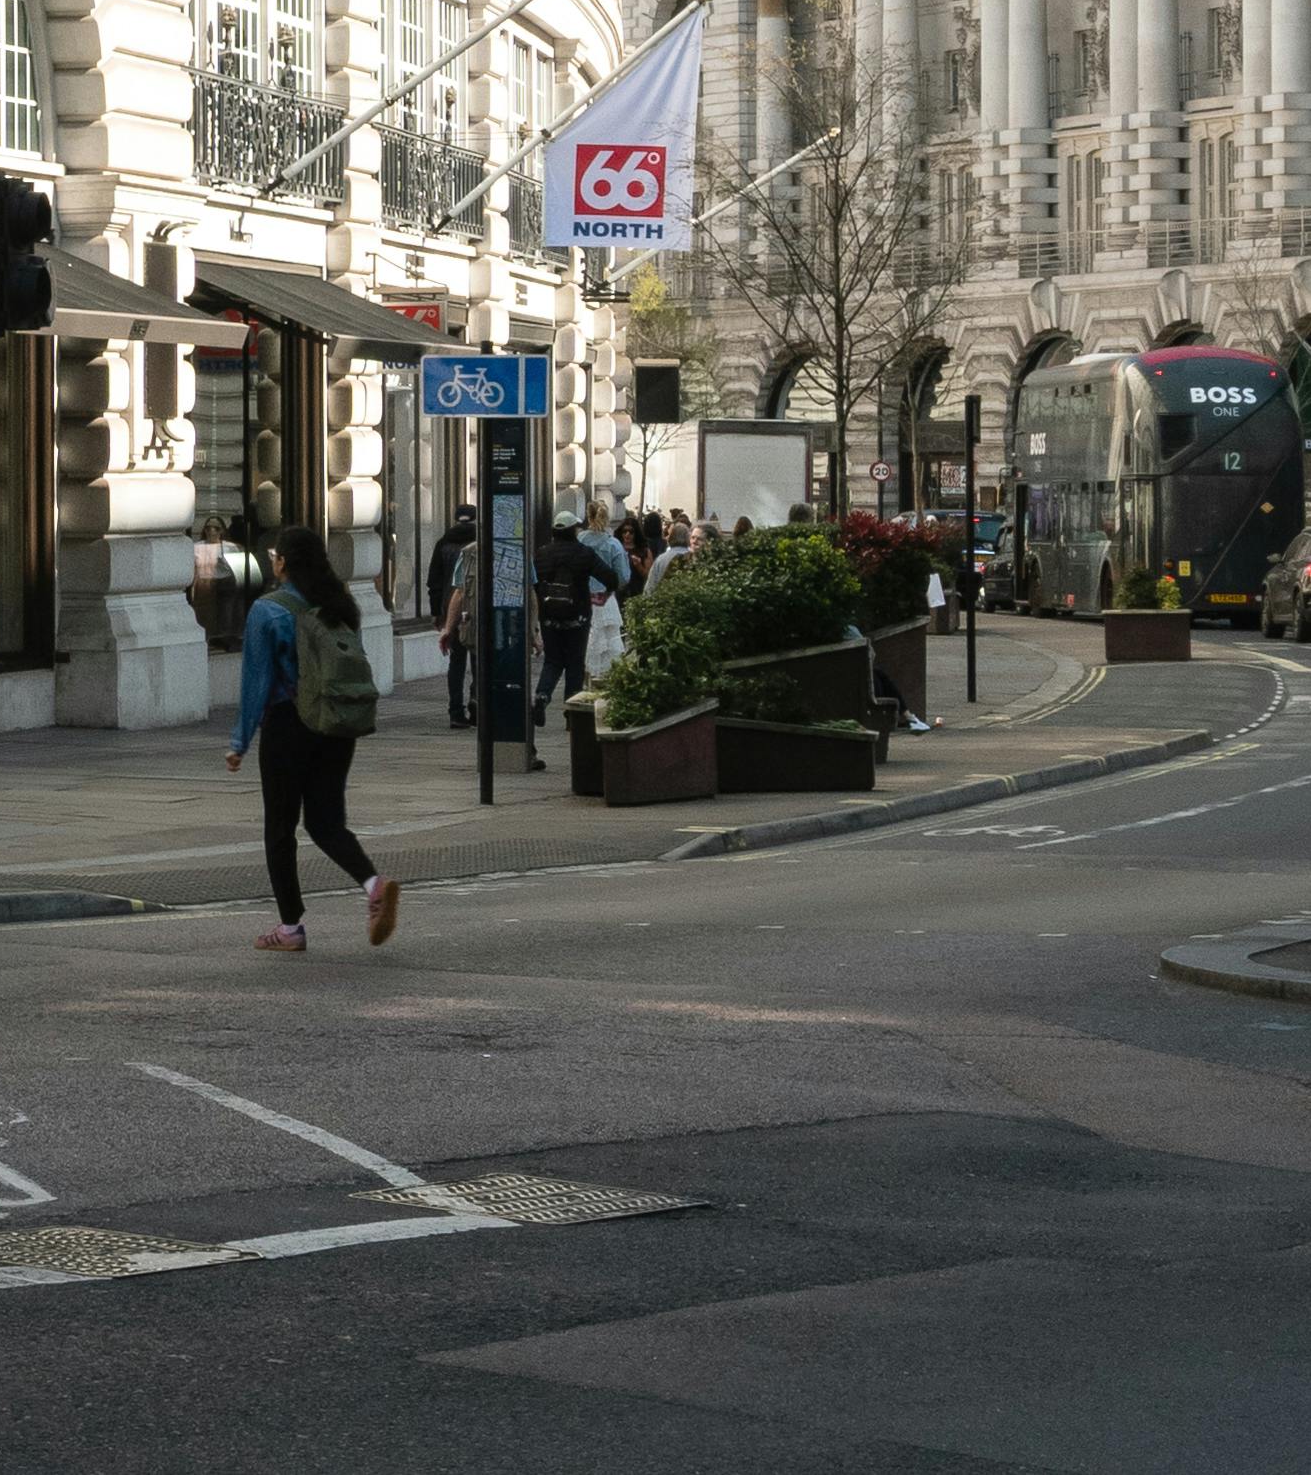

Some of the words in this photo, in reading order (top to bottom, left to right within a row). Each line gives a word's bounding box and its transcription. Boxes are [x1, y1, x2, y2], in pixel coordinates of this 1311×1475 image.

[573, 221, 663, 239] NORTH
[382, 359, 420, 370] NOR
[1189, 386, 1258, 404] BOSS
[1212, 406, 1241, 417] ONE
[1030, 432, 1046, 455] BOSS
[1224, 451, 1242, 471] 12
[874, 465, 890, 477] 20
